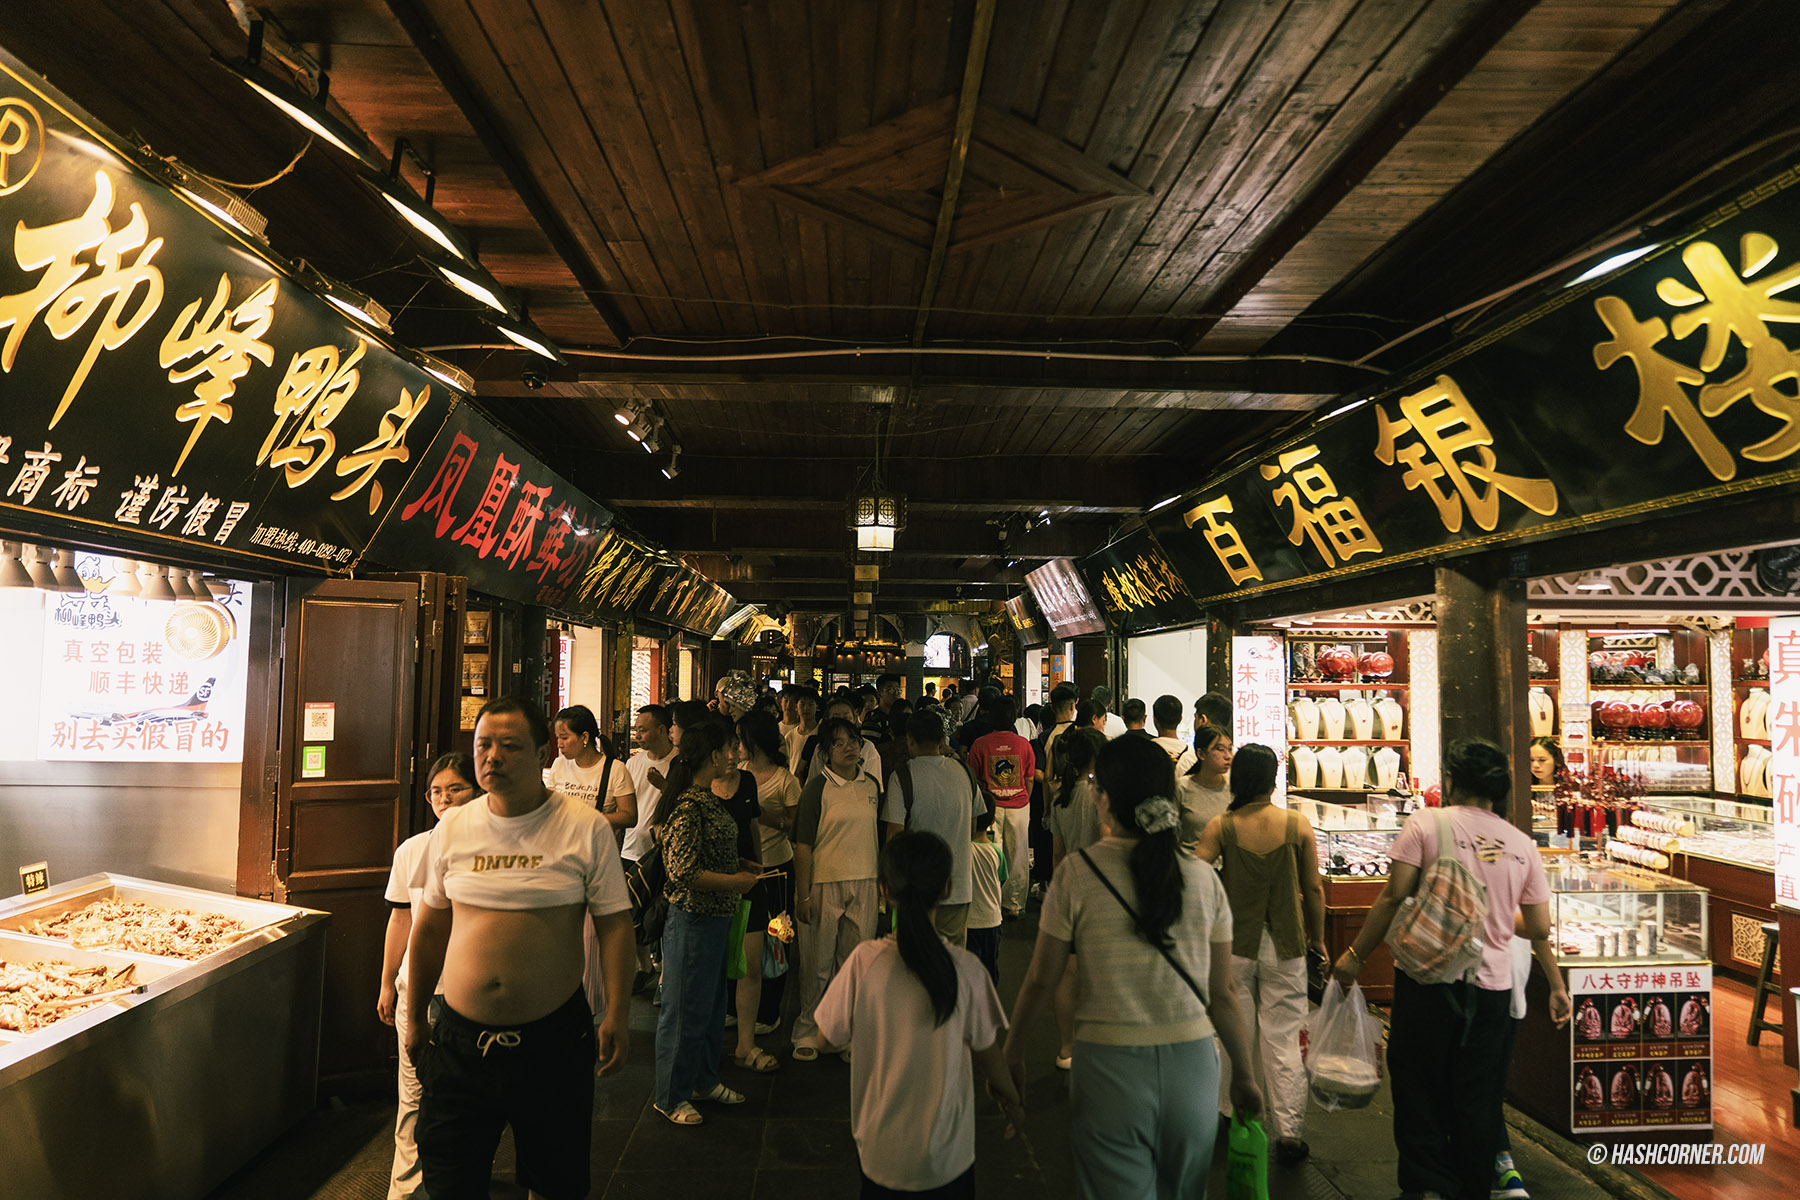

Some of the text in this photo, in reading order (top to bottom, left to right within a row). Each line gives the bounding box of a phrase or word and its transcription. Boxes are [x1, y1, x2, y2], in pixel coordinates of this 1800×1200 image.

[1183, 231, 1800, 588] 百福银楼
[115, 474, 249, 545] 谨防假冒
[401, 430, 597, 590] 凤凰酥鲜坊
[1102, 548, 1188, 613] 酸奶冰淇淋
[63, 639, 164, 664] 真空包装
[88, 671, 190, 696] 顺丰快递
[198, 685, 213, 699] SF
[1236, 662, 1260, 748] 朱砂批
[1264, 668, 1281, 739] 假一赔十
[50, 719, 229, 753] 别去买假冒的
[1581, 971, 1701, 990] 八大守护神吊坠
